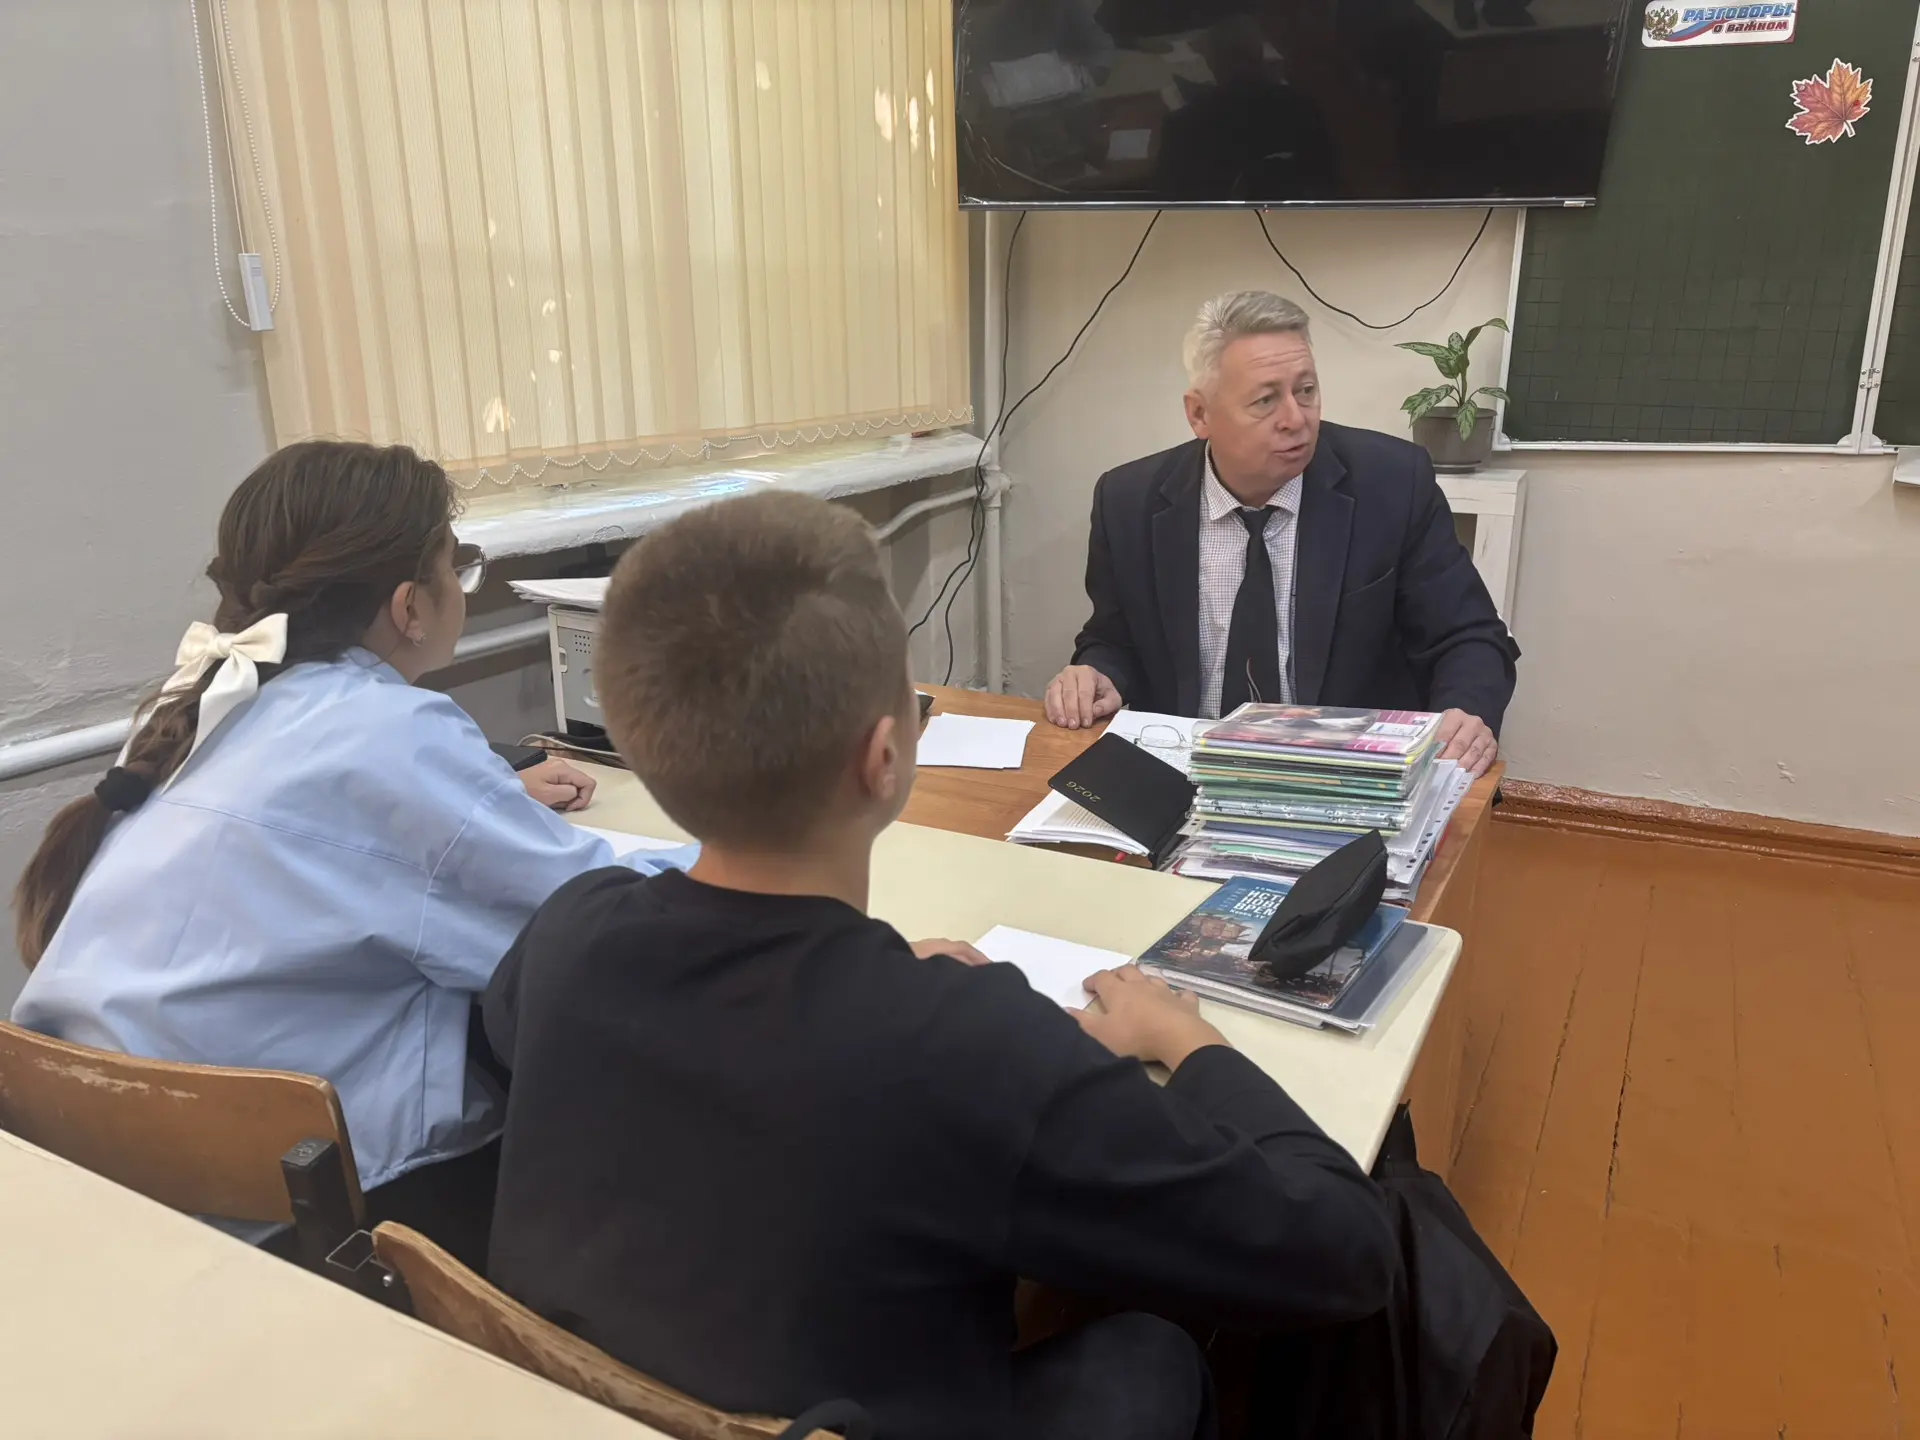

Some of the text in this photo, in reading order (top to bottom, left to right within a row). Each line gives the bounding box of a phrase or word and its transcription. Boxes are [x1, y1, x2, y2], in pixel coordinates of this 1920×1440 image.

[1682, 3, 1794, 22] РАЗГОВОРЫ
[1726, 21, 1789, 32] важном
[1066, 781, 1101, 803] 2026
